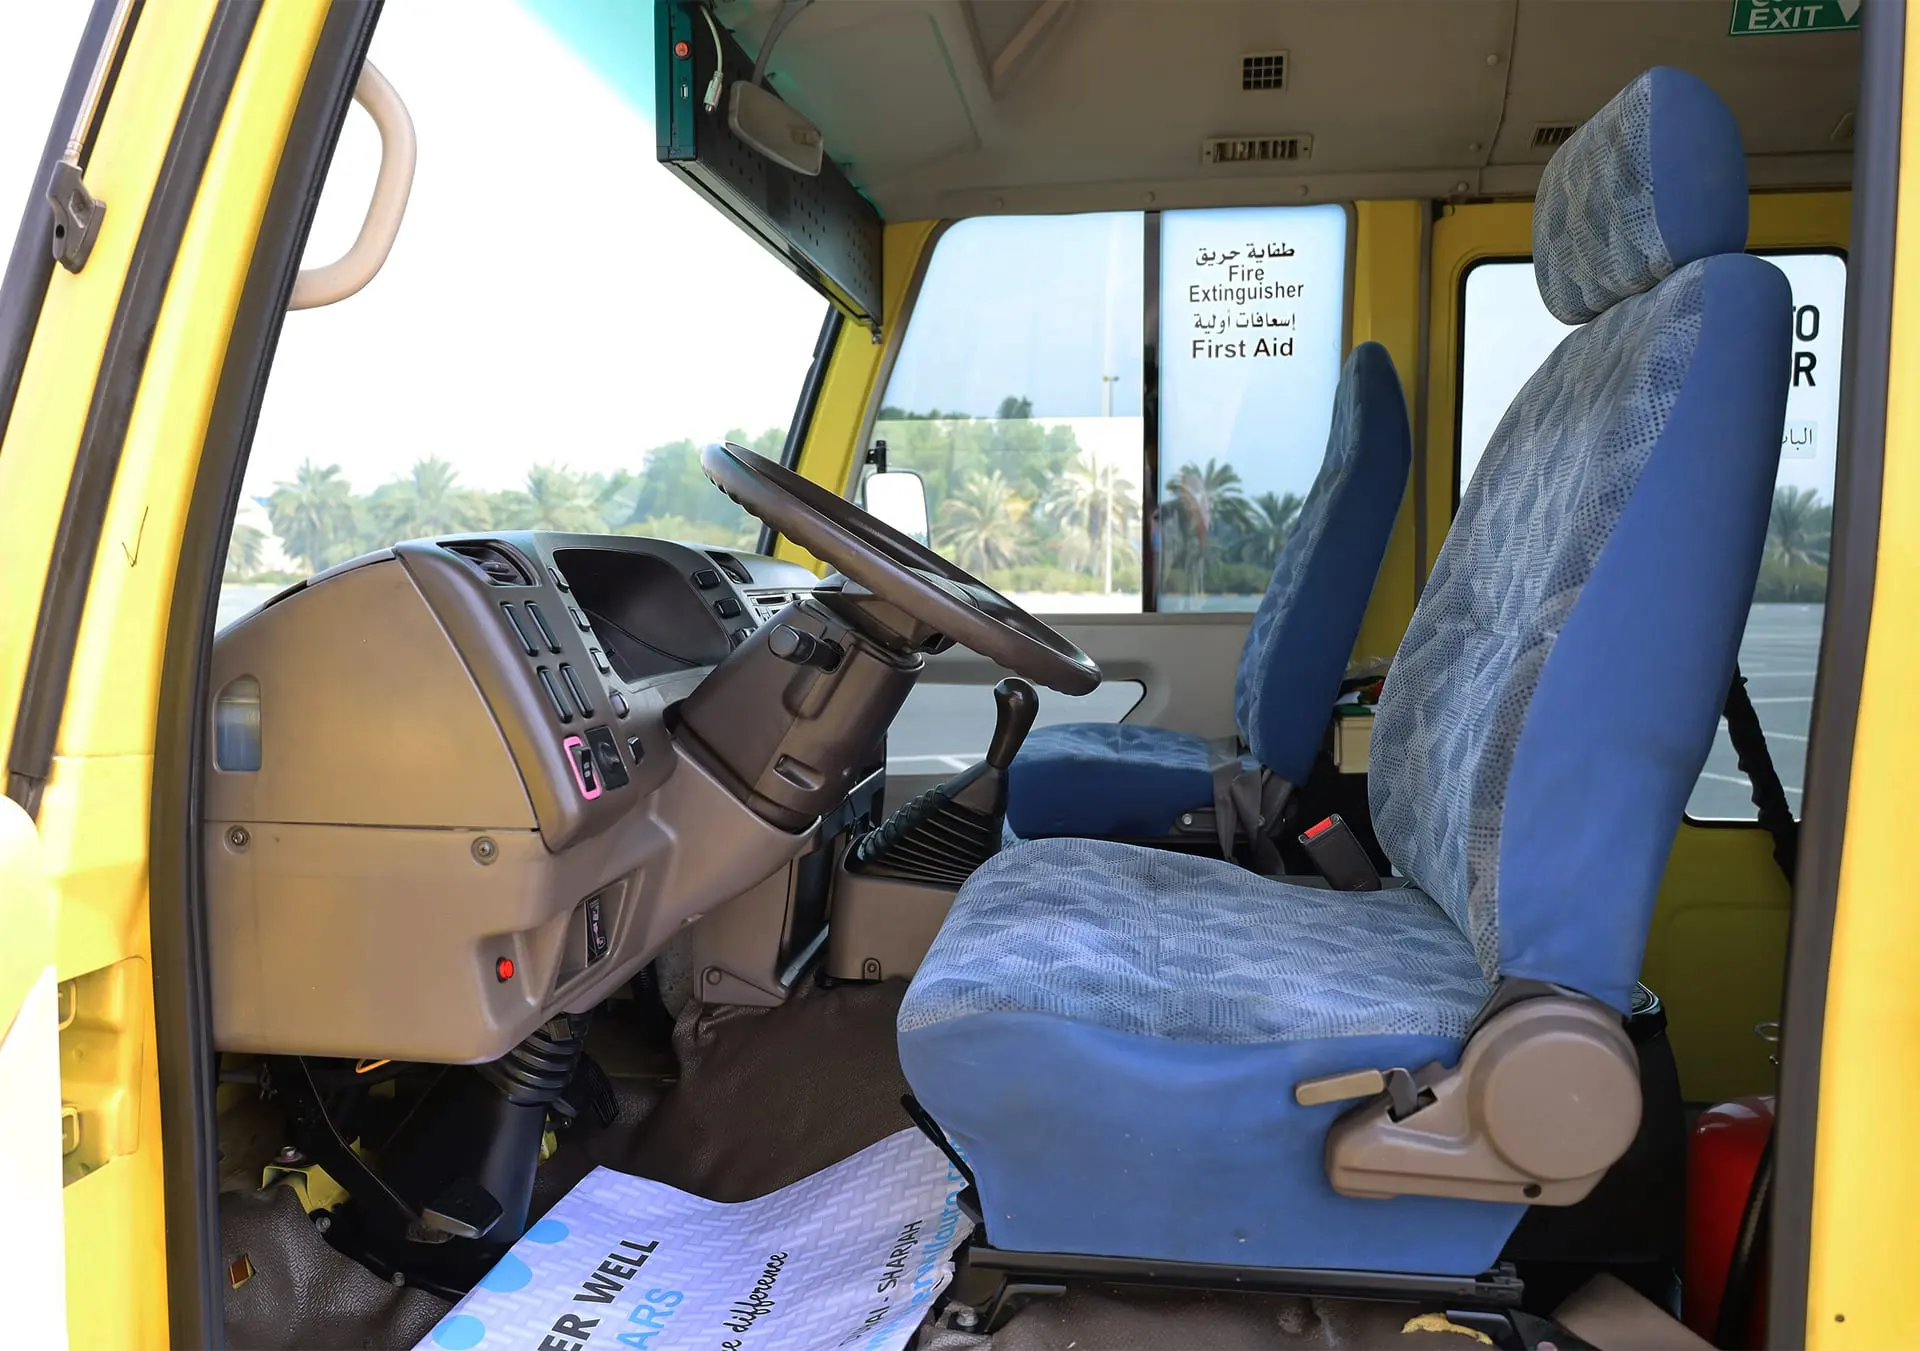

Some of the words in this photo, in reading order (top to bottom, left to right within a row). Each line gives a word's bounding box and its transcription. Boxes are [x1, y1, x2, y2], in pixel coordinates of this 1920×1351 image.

[1747, 5, 1823, 30] EXIT
[1195, 247, 1240, 266] حريق
[1246, 242, 1295, 263] طفاية
[1228, 264, 1265, 282] Fire
[1189, 281, 1304, 305] Extinguisher
[1194, 309, 1231, 334] أولية
[1236, 311, 1296, 331] إسعافات
[1793, 304, 1820, 342] O
[1192, 339, 1246, 359] First
[1253, 337, 1294, 357] Aid
[1793, 351, 1817, 387] R
[877, 1219, 923, 1293] SHARJAH
[537, 1313, 601, 1351] ER
[573, 1239, 660, 1304] WELL
[722, 1251, 788, 1333] difference
[616, 1288, 684, 1351] ARS
